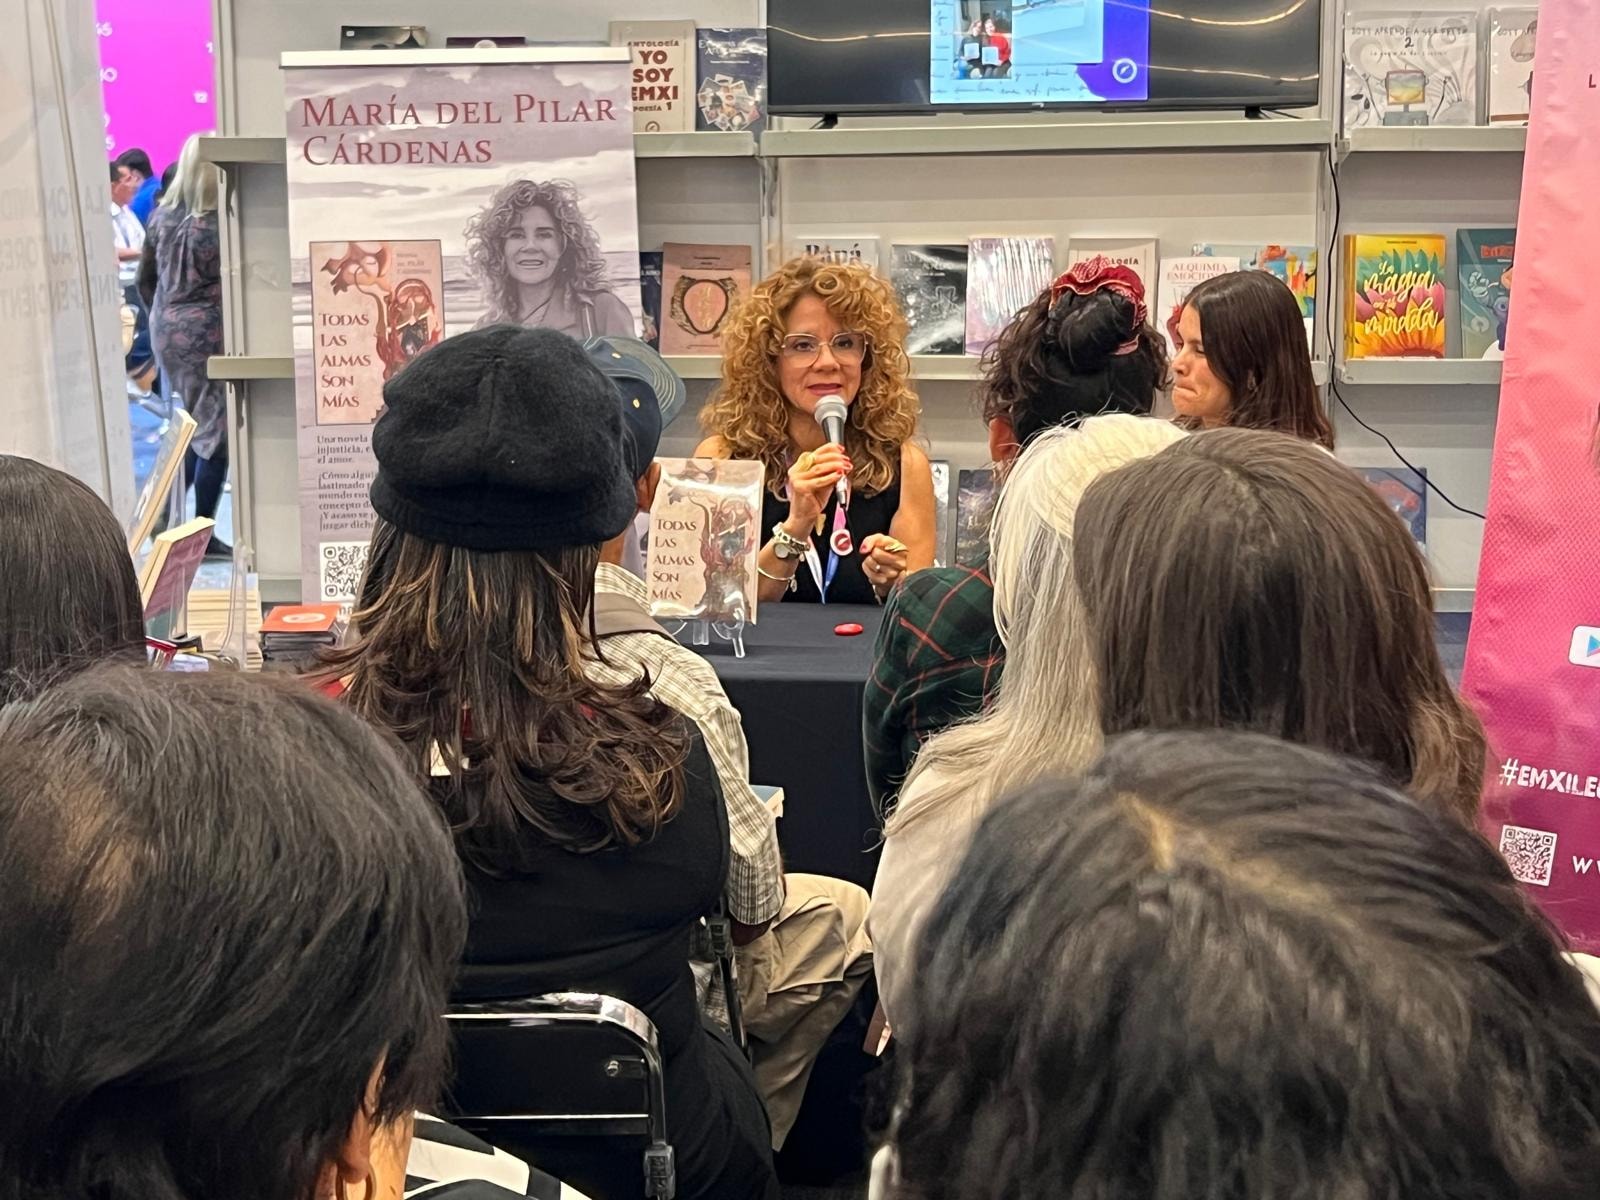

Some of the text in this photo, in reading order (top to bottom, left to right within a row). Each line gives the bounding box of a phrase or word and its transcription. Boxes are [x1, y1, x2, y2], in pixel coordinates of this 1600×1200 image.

[1405, 37, 1414, 48] 2
[638, 50, 667, 65] YO
[633, 68, 673, 82] SOY
[632, 85, 678, 101] EMXI
[302, 94, 421, 128] MARÍA
[513, 93, 617, 122] PILAR
[666, 101, 672, 111] 1
[303, 135, 492, 165] CÁRDENAS
[1364, 267, 1435, 302] magia
[320, 313, 370, 326] TODAS
[320, 333, 347, 347] LAS
[321, 354, 371, 367] ALMAS
[321, 375, 354, 388] SON
[322, 392, 360, 408] MÍAS
[337, 434, 368, 443] novela
[657, 518, 696, 531] TODAS
[655, 536, 677, 548] LAS
[654, 554, 695, 566] ALMAS
[653, 571, 679, 583] SON
[651, 587, 682, 600] MÍAS
